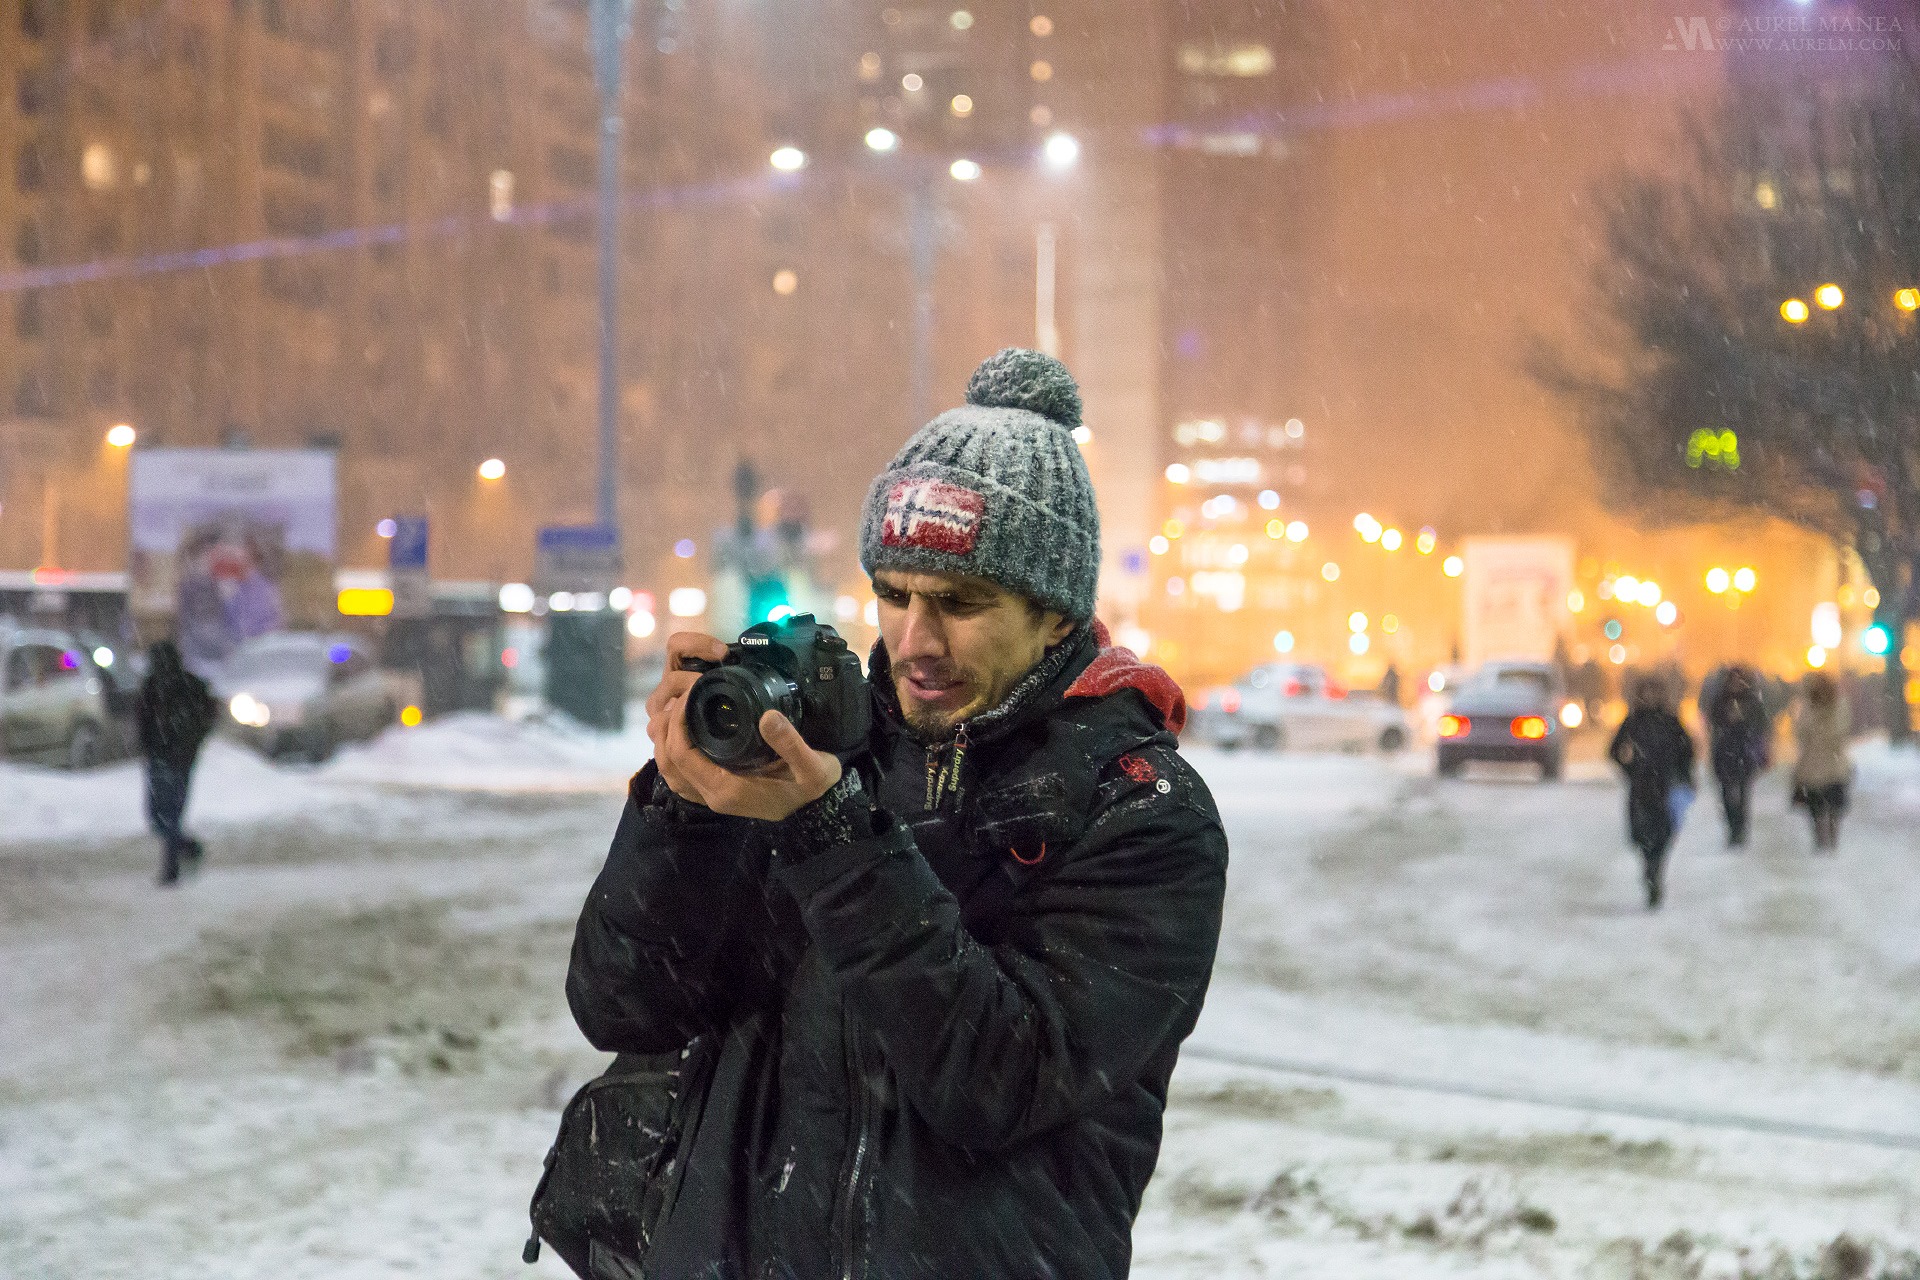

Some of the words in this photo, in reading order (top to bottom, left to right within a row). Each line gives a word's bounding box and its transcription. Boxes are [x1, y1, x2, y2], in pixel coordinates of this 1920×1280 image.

[740, 636, 769, 646] Canon
[924, 768, 936, 810] Superdry
[948, 748, 964, 791] Superdry
